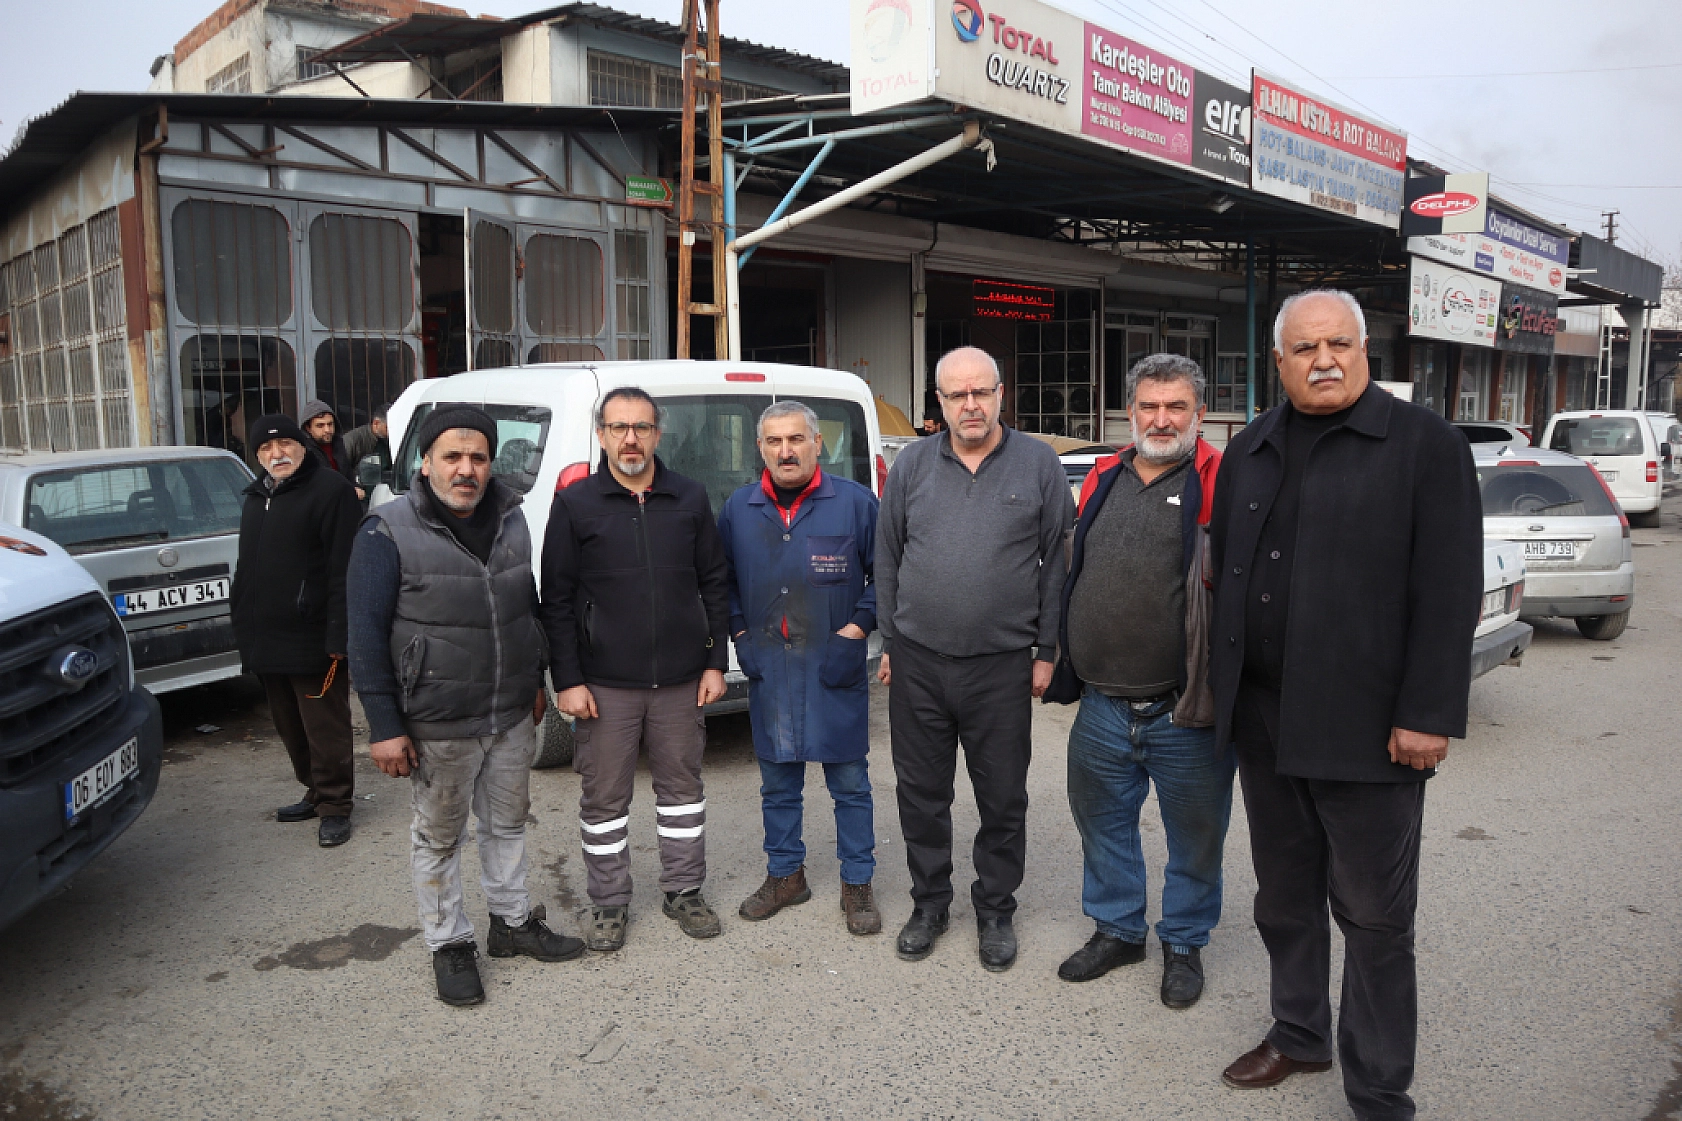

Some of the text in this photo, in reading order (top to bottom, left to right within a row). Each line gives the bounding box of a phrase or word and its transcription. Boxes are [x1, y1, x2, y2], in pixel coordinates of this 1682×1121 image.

[989, 13, 1059, 65] TOTAL
[986, 52, 1070, 104] QUARTZ
[1091, 33, 1190, 98] Kardeşler Oto
[1092, 70, 1120, 98] Tamir
[860, 71, 919, 98] TOTAL
[1300, 101, 1331, 136] USTA
[1333, 121, 1340, 140] &
[1343, 120, 1364, 147] ROT
[1417, 199, 1471, 210] DELPHI
[1525, 542, 1571, 554] AHB 739
[127, 582, 224, 611] 44 ACV 341
[74, 775, 89, 809] 06
[96, 756, 115, 794] EOY
